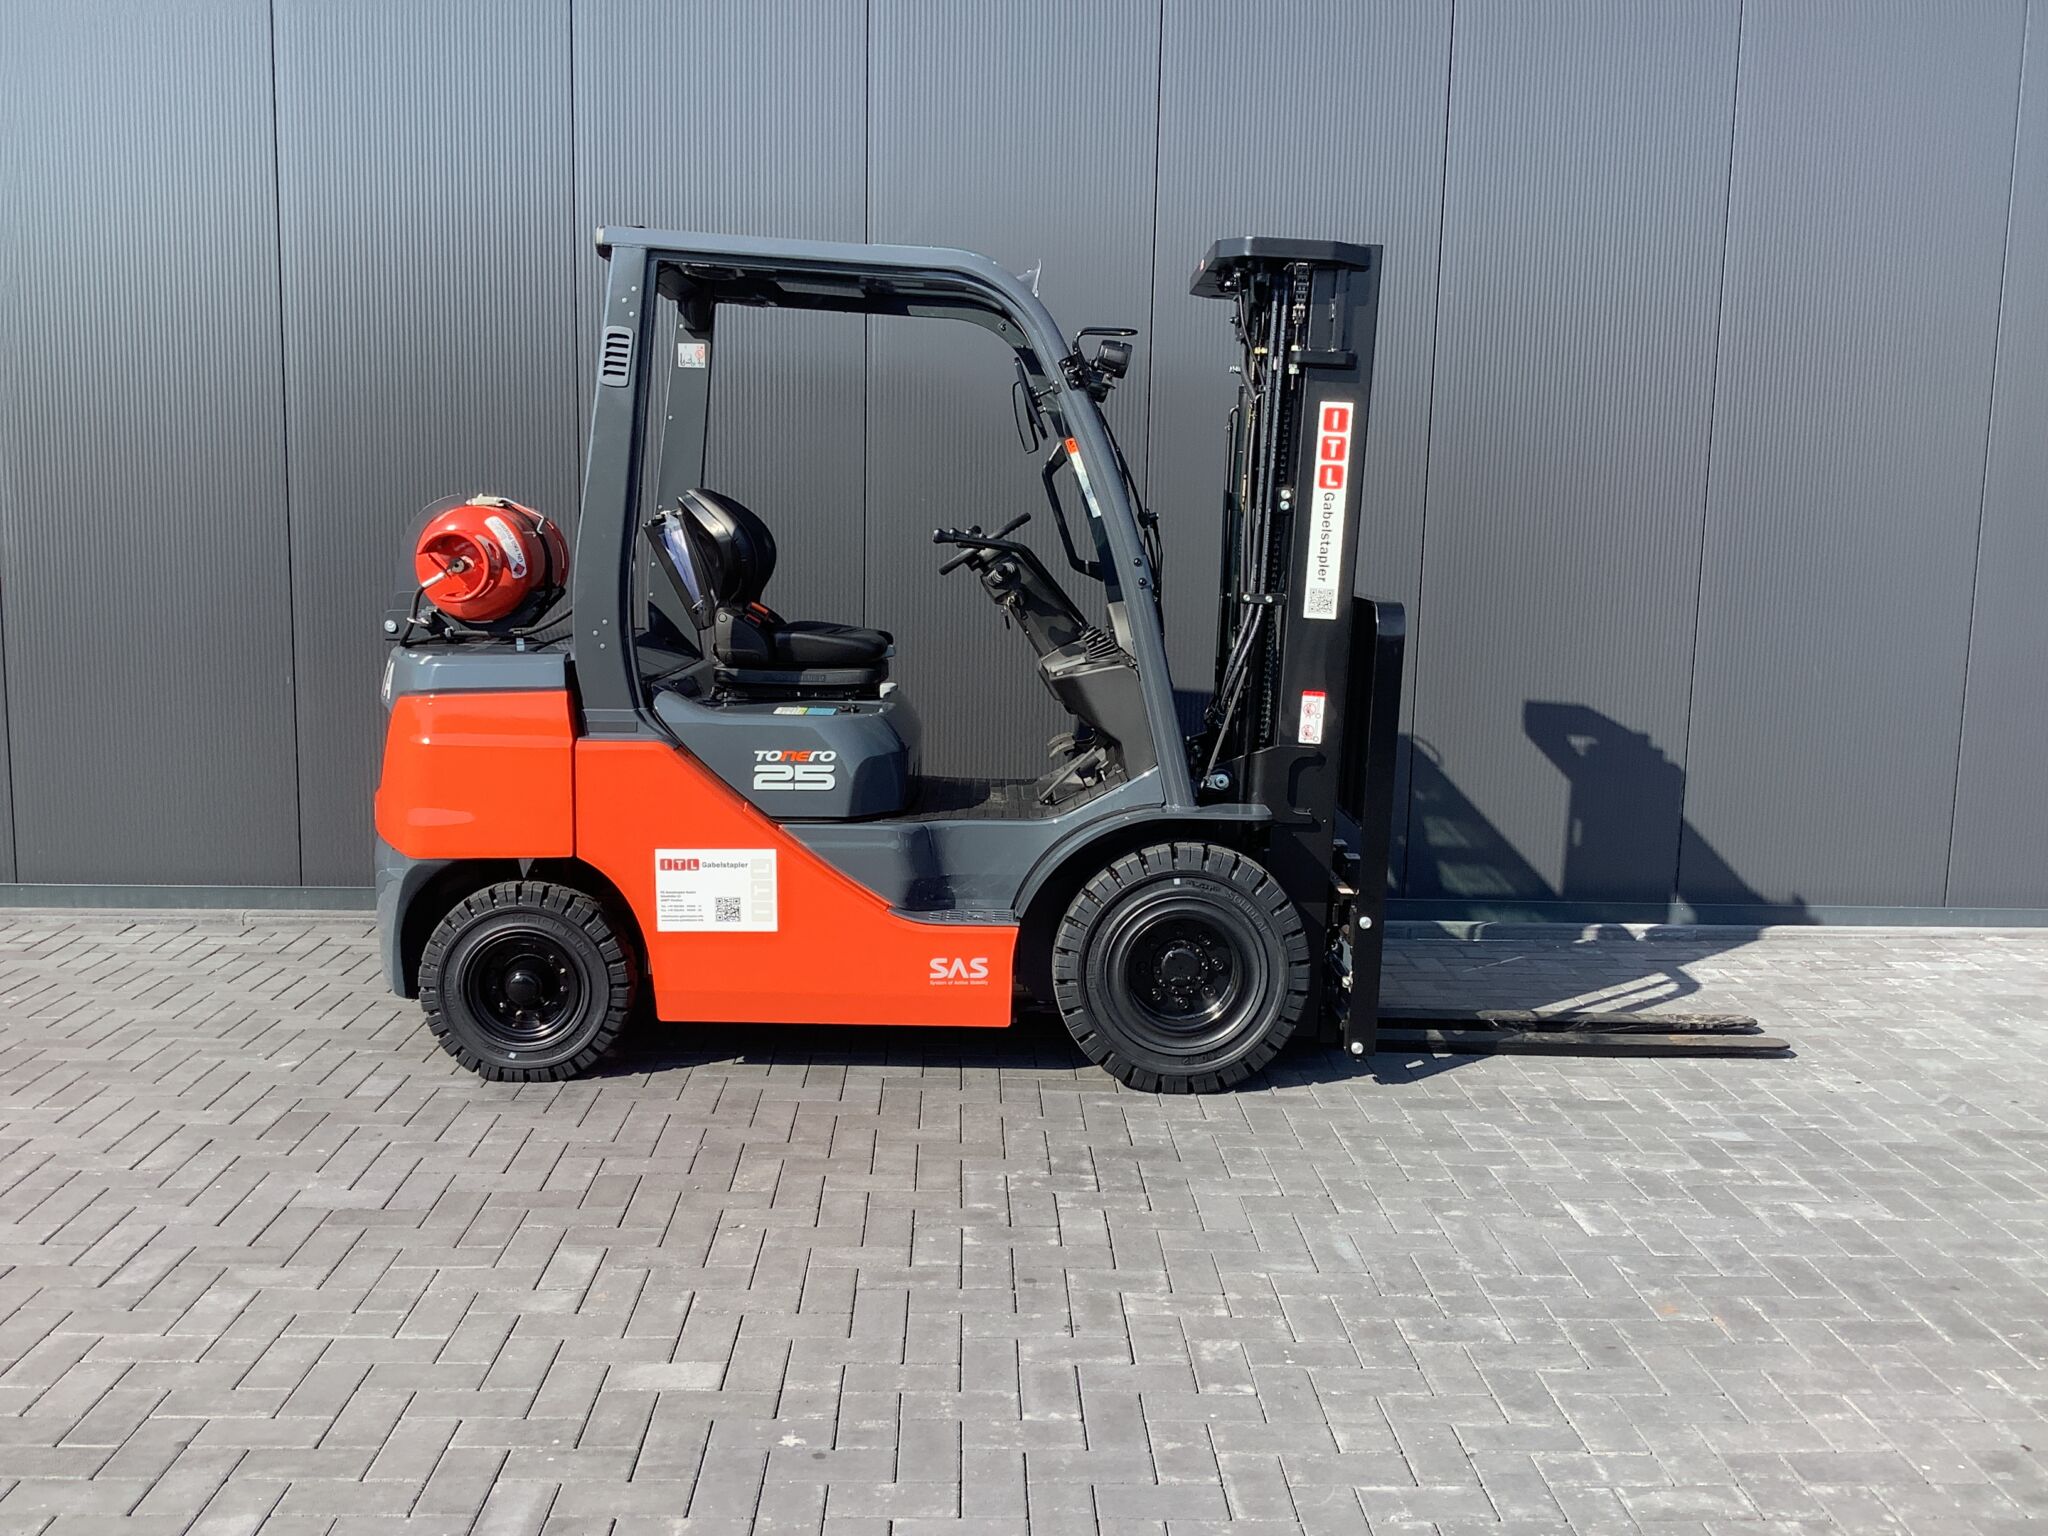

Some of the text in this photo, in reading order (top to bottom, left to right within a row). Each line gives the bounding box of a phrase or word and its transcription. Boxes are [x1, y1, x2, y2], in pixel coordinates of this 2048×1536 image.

[1322, 408, 1345, 487] ITL
[1317, 492, 1335, 582] Gabelstapler
[753, 765, 836, 791] 25
[662, 860, 748, 870] ITL Gabelstapler
[929, 957, 989, 979] SAS
